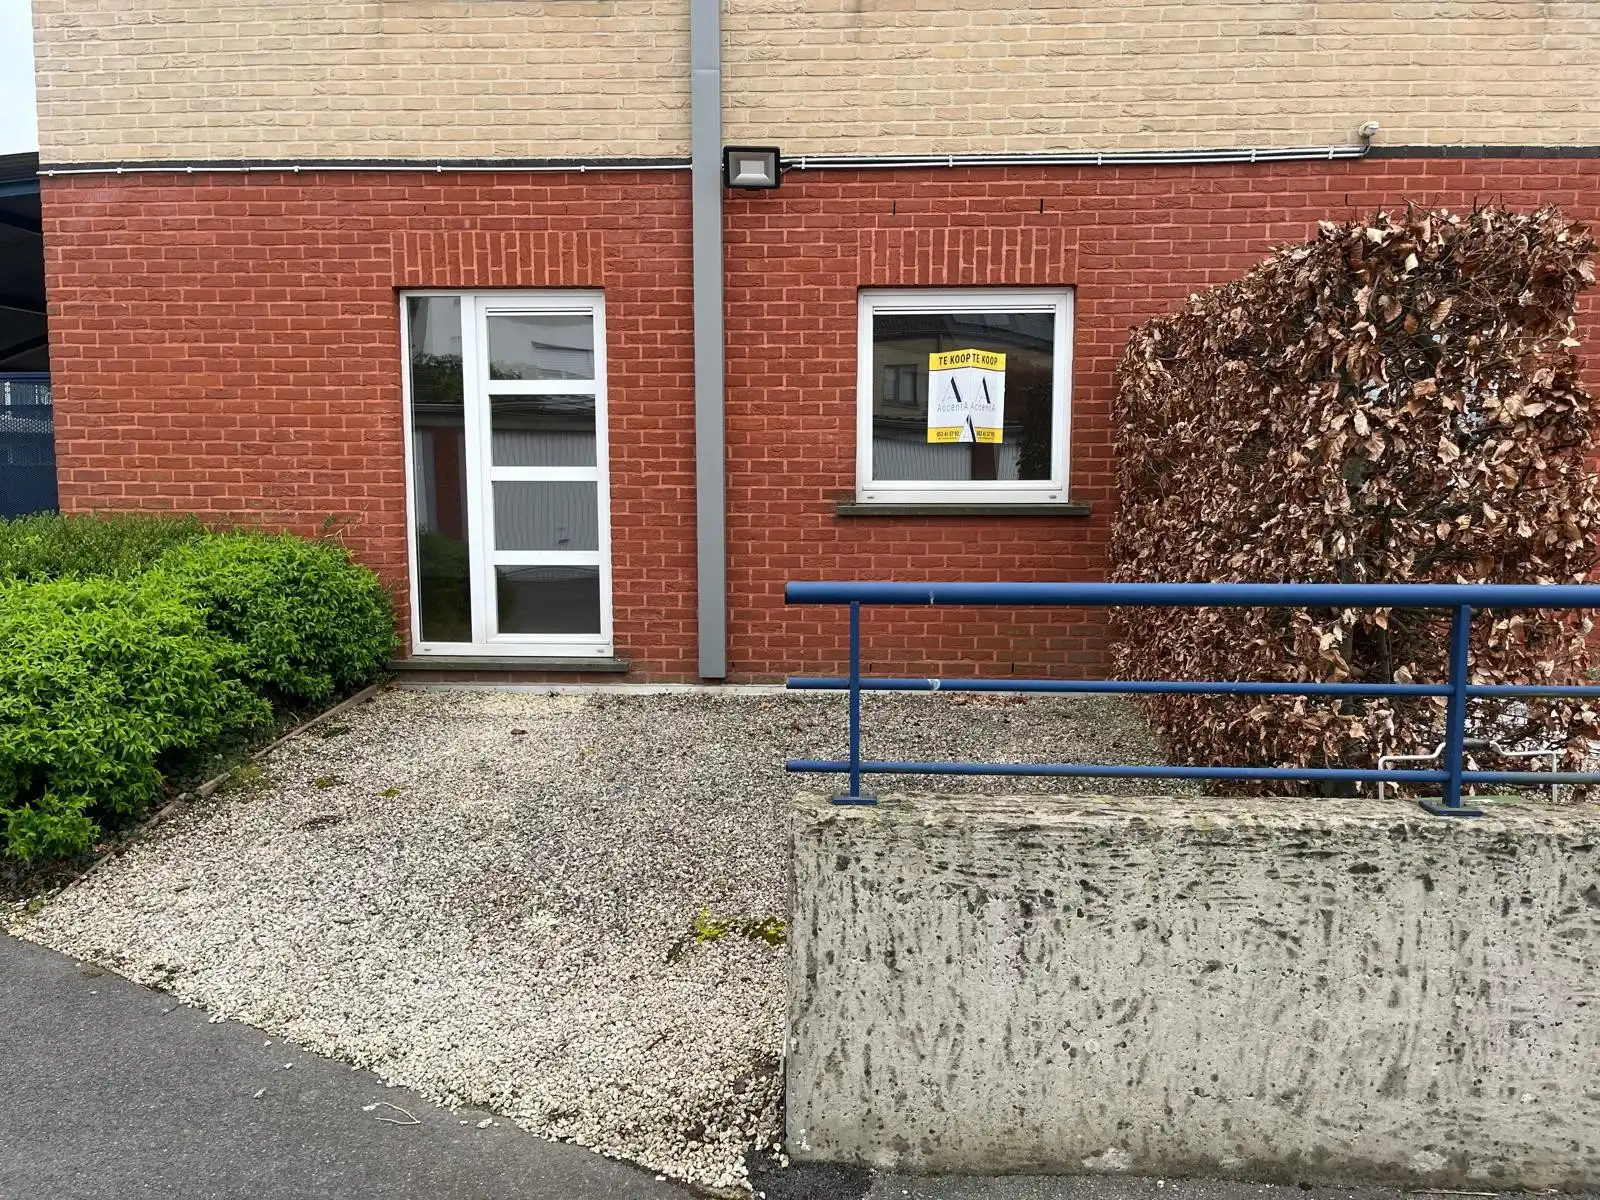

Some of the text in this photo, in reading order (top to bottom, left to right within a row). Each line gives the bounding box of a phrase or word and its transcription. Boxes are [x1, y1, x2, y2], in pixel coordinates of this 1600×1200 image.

[938, 353, 971, 365] TE KOOP
[972, 353, 998, 366] TE KOOP
